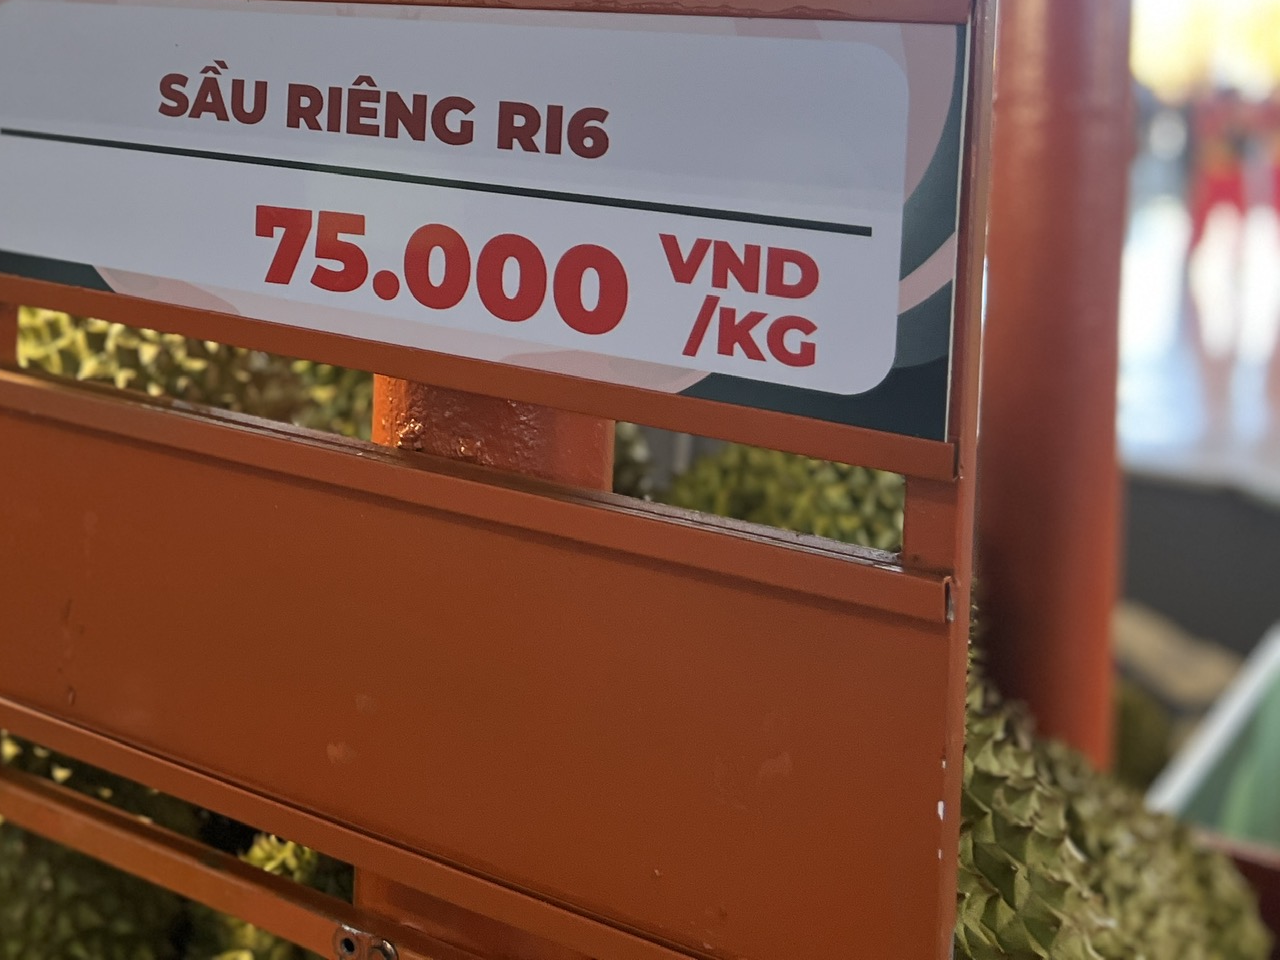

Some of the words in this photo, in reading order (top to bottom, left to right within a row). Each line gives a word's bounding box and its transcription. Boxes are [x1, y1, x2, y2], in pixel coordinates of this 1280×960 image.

[157, 59, 268, 125] SẦU
[286, 75, 475, 145] RIÊNG
[496, 101, 609, 159] RI6
[254, 204, 628, 336] 75.000
[658, 232, 819, 300] VND
[681, 294, 818, 368] /KG
